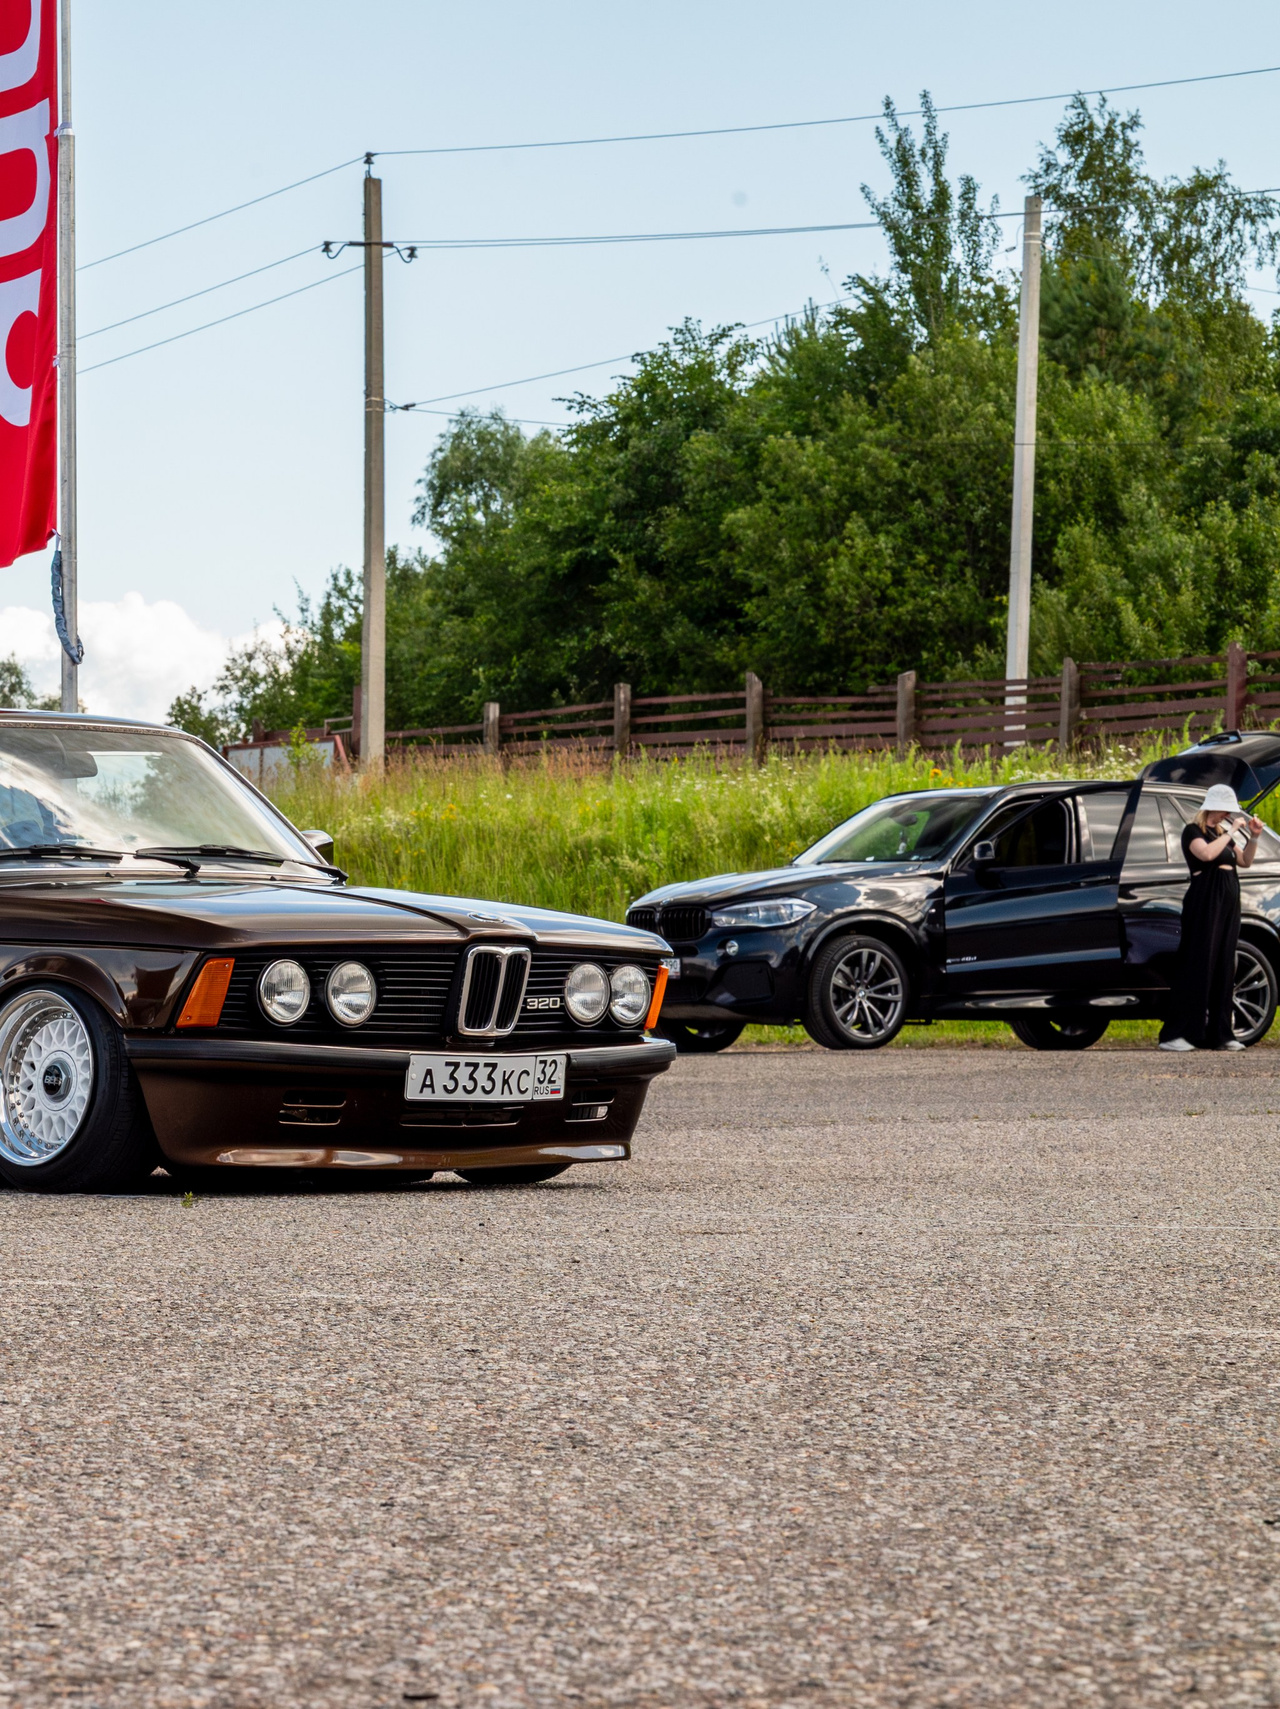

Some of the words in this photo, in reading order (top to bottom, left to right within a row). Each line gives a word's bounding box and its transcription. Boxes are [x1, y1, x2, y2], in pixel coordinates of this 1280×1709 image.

[526, 997, 560, 1010] 320
[537, 1058, 559, 1085] 32
[534, 1085, 550, 1096] RUS
